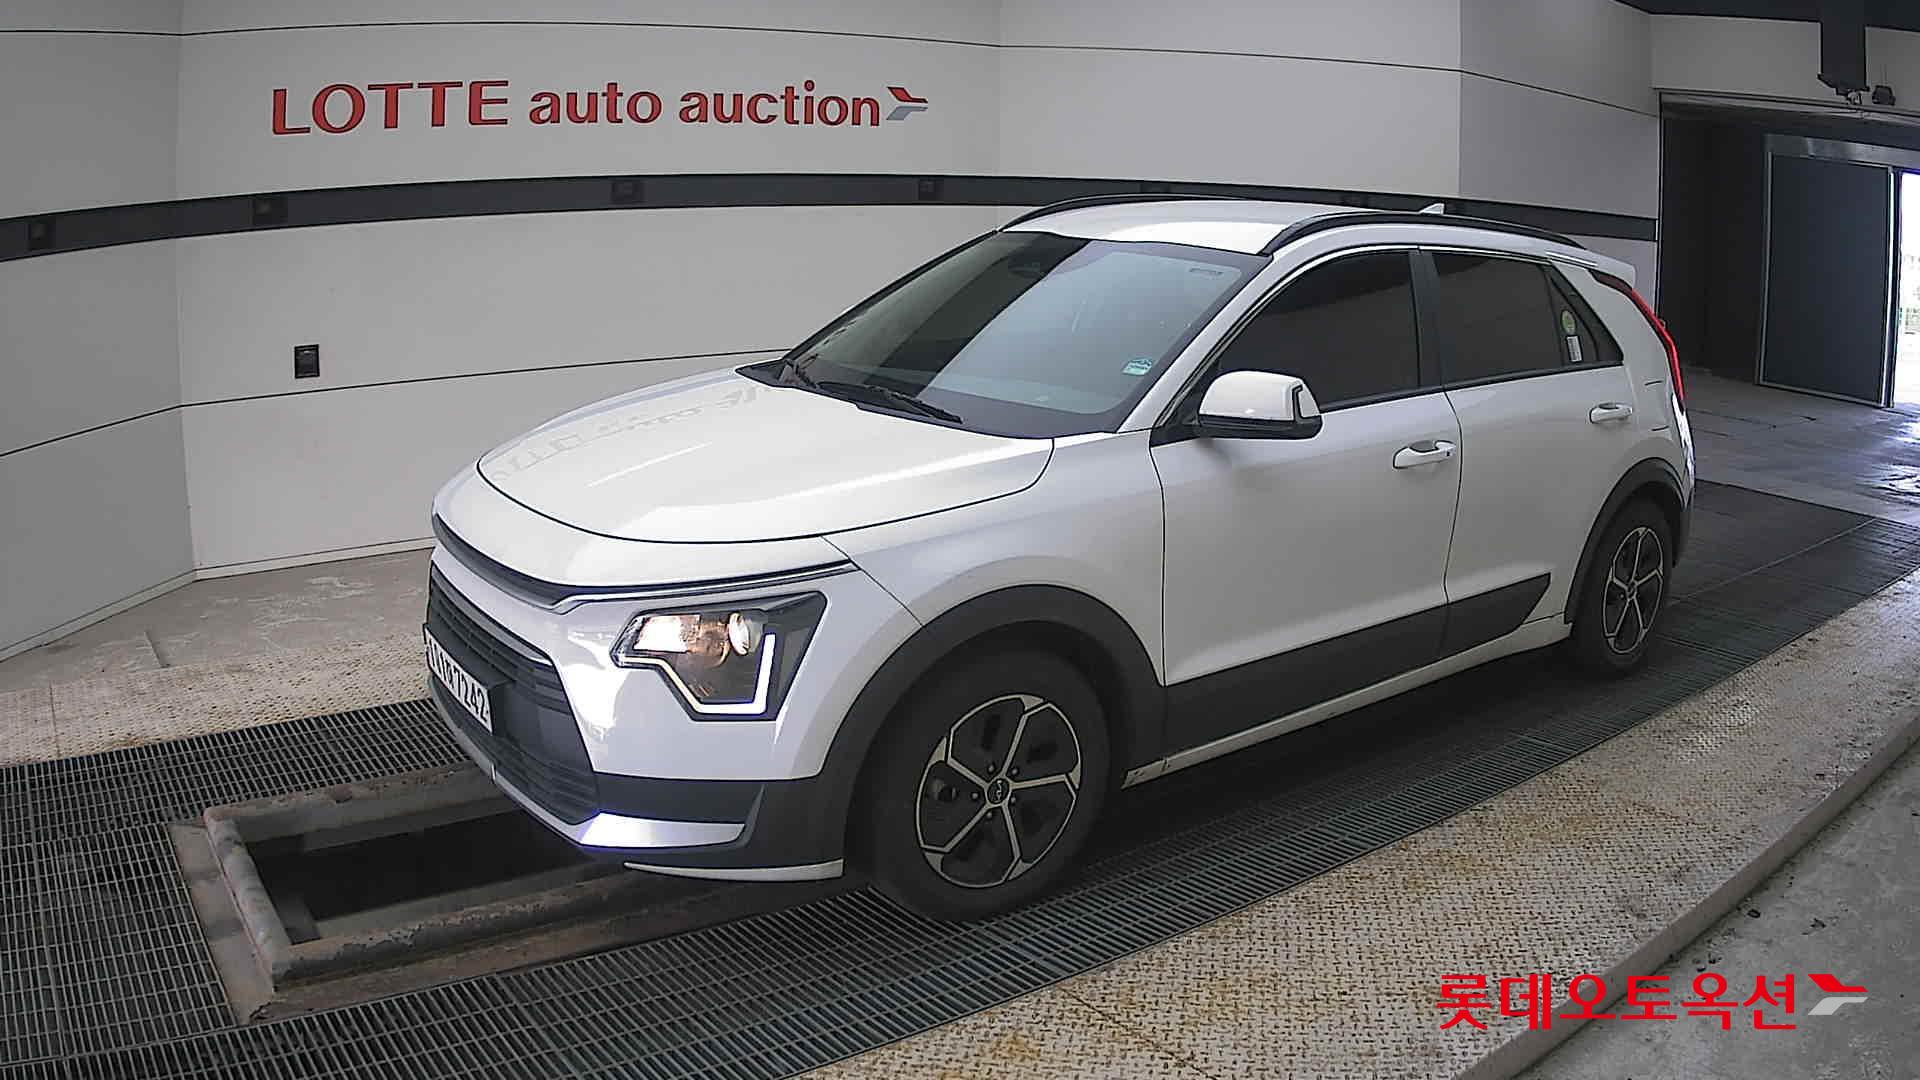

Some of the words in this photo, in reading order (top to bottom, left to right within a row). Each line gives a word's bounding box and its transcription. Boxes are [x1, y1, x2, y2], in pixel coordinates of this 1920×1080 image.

[272, 80, 509, 136] LOTTE
[529, 82, 663, 125] auto
[679, 79, 880, 127] auction
